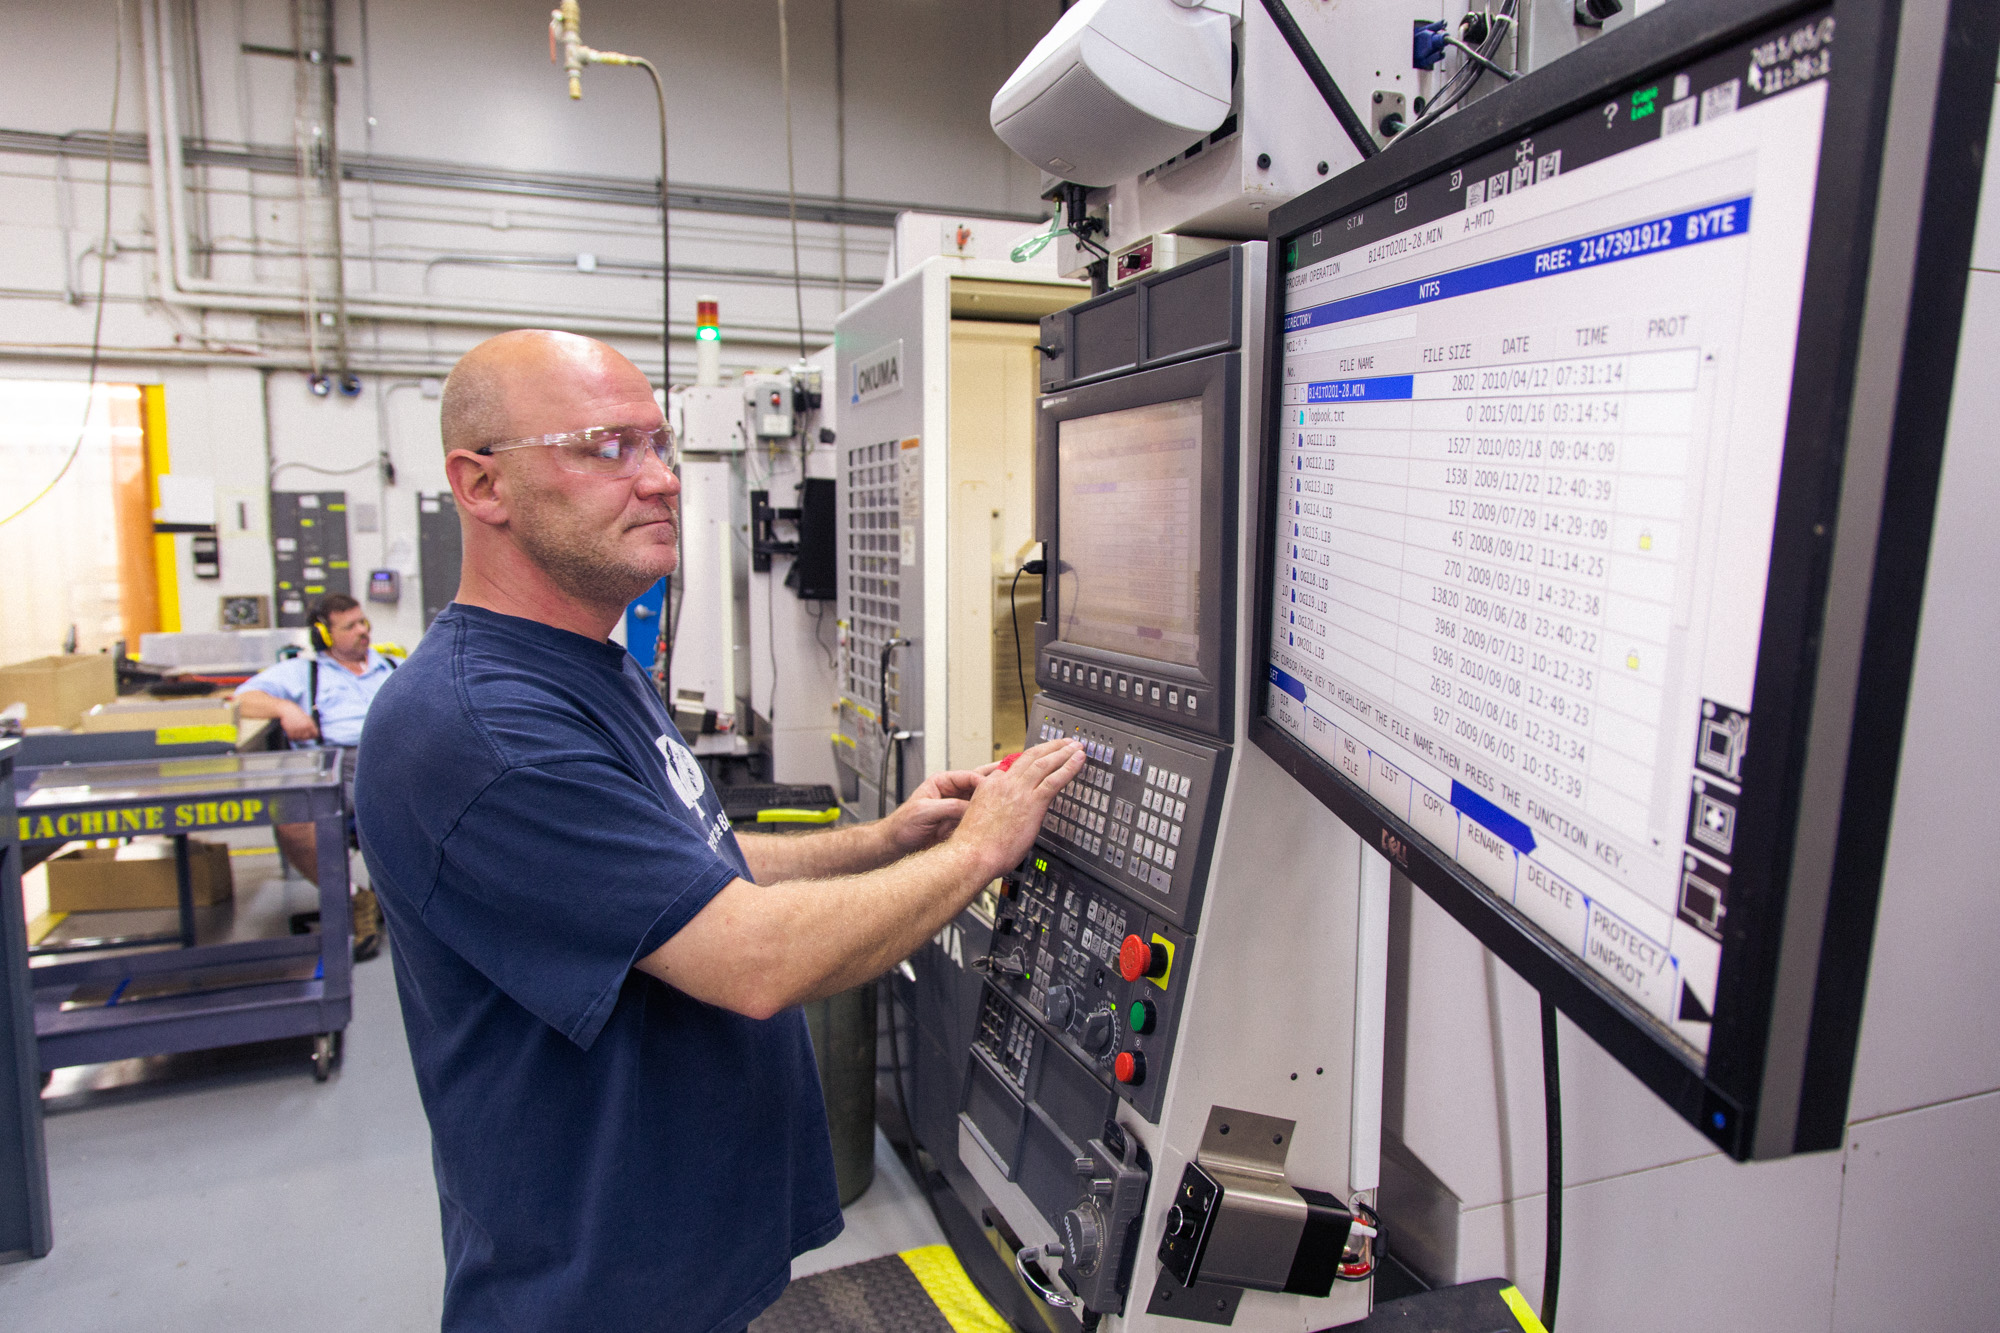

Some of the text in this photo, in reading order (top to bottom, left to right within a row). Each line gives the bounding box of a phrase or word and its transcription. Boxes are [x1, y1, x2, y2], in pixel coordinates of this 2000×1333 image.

[1367, 209, 1495, 264] B141T0201-28.MIN A-MTD
[1284, 206, 1737, 330] DIRECTORY NTFS FREE: 2147391912 BYTE
[1286, 262, 1340, 289] PROGRAM OPERATION
[1339, 357, 1354, 372] FILE
[1357, 355, 1374, 369] NAME
[1422, 346, 1443, 363] FILE
[1448, 342, 1471, 361] SIZE
[1502, 335, 1529, 355] DATE
[1575, 325, 1606, 346] TIME
[1647, 315, 1687, 336] PROT
[1451, 373, 1474, 391] 2802
[1481, 367, 1547, 391] 2010/04/12
[1556, 363, 1622, 386] 07:31:14
[1308, 407, 1344, 425] logbook.txt
[1466, 405, 1472, 422] 0
[1478, 403, 1544, 423] 2015/01/16
[1552, 403, 1618, 423] 03:14:54
[1447, 436, 1470, 454] 1527
[1476, 437, 1541, 458] 2010/03/18
[1549, 440, 1614, 462] 09:04:09
[1445, 466, 1467, 485] 1538
[1474, 469, 1538, 493] 2009/12/22
[1546, 476, 1611, 500] 12:40:39
[1448, 498, 1465, 516] 152
[1471, 501, 1535, 527] 2009/07/29
[1543, 512, 1607, 539] 14:29:09
[1451, 529, 1463, 547] 45
[1469, 533, 1532, 562] 2008/09/12
[1540, 547, 1603, 577] 11:14:25
[1444, 558, 1460, 578] 270
[1466, 565, 1529, 596] 2009/03/19
[1537, 583, 1599, 616] 14:32:38
[1431, 586, 1458, 608] 13820
[1464, 595, 1526, 630] 2009/06/28
[1534, 617, 1596, 652] 23:40:22
[1434, 616, 1455, 639] 3968
[1462, 626, 1523, 664] 2009/07/13
[1531, 652, 1592, 691] 10:12:35
[1280, 693, 1288, 707] DIR
[1432, 645, 1453, 668] 9296
[1459, 656, 1520, 697] 2010/09/08
[1528, 686, 1588, 727] 12:49:23
[1279, 709, 1299, 729] DISPLAY
[1313, 716, 1326, 734] EDIT
[1430, 674, 1451, 698] 2633
[1457, 687, 1516, 730] 2010/08/16
[1525, 720, 1585, 761] 12:31:34
[1280, 653, 1312, 681] CURSOR/PAGE
[1314, 675, 1325, 688] KEY
[1327, 680, 1335, 696] TO
[1337, 688, 1372, 713] HIGHLIGHT
[1374, 708, 1388, 728] THE
[1391, 718, 1409, 741] FILE
[1464, 762, 1493, 792] PRESS
[1501, 783, 1520, 807] THE
[1527, 799, 1587, 847] FUNCTION
[1595, 840, 1628, 874] KEY.
[1342, 755, 1358, 777] FILE
[1344, 737, 1356, 755] NEW
[1433, 705, 1450, 725] 927
[1455, 717, 1514, 762] 2009/06/05
[1521, 753, 1581, 799] 10:55:39
[1380, 763, 1398, 784] LIST
[175, 799, 263, 827] SHOP
[1423, 793, 1444, 817] COPY
[1468, 824, 1505, 861] RENAME
[1528, 865, 1573, 909] DELETE
[1594, 910, 1667, 976] PROTECT/
[1591, 937, 1650, 997] UNPROT.
